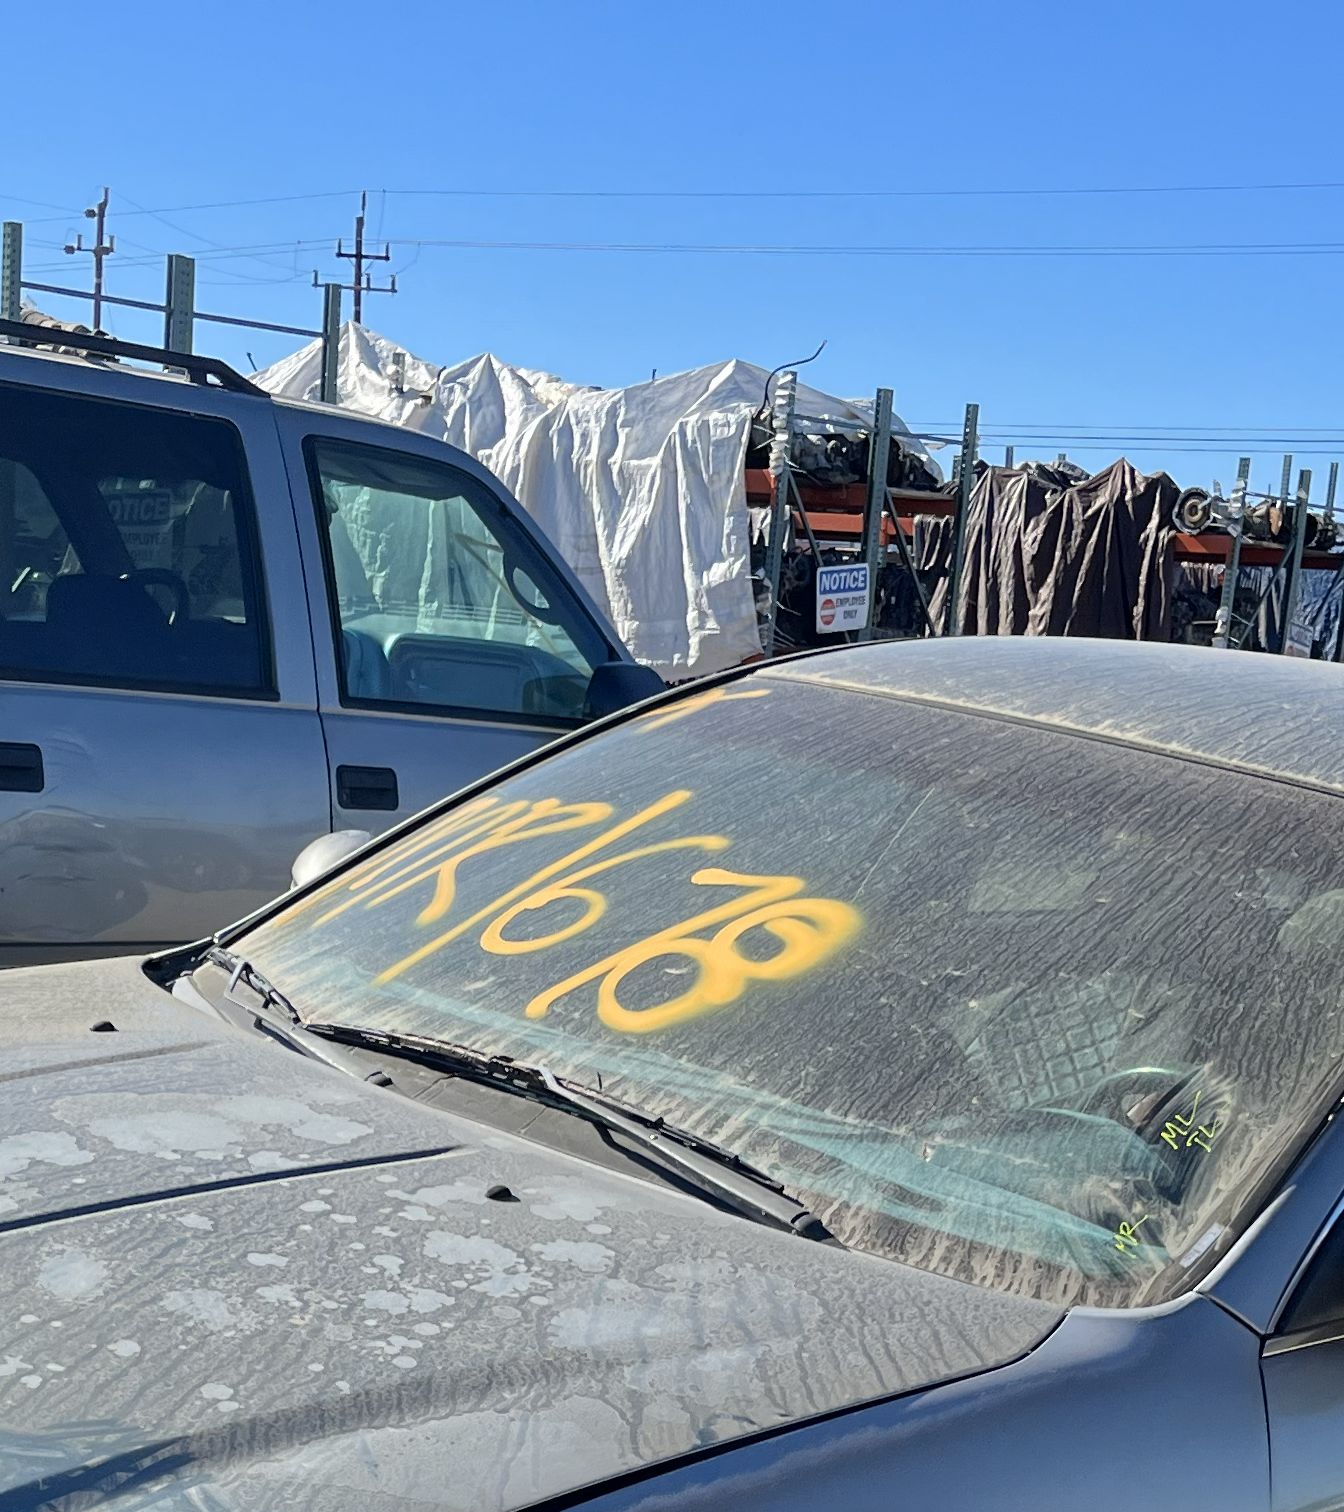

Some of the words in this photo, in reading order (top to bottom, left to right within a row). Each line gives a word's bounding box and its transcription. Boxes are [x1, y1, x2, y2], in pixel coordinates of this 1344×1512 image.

[108, 497, 168, 520] OTICE
[821, 570, 865, 592] NOTICE
[1160, 1090, 1202, 1150] ML
[1113, 1214, 1149, 1258] MR
